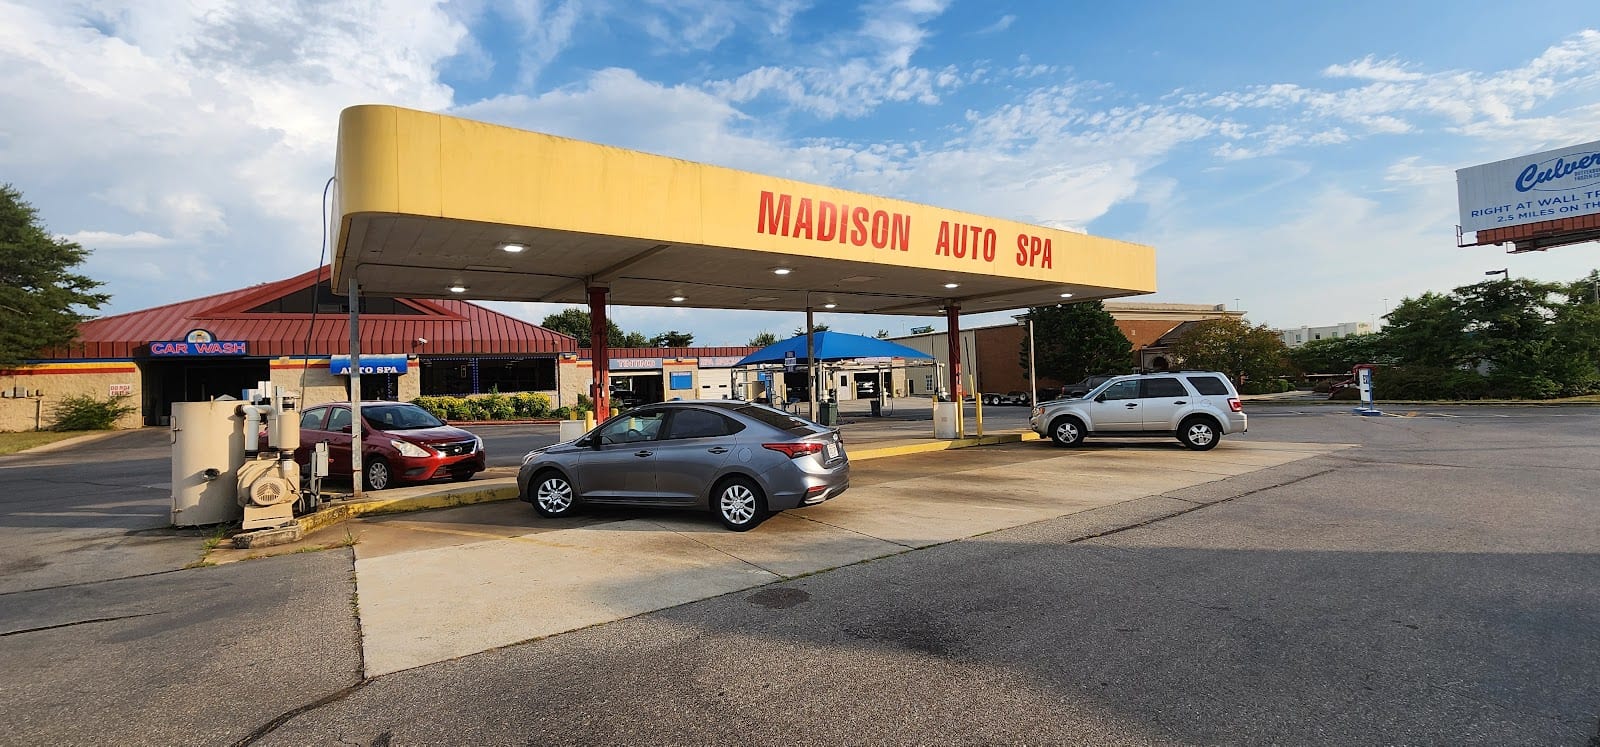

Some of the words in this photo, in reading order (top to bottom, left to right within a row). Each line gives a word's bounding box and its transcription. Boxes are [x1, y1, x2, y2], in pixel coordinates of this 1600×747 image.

[1471, 204, 1511, 218] RIGHT
[1516, 201, 1532, 210] AT
[1538, 193, 1579, 206] WALL
[1497, 215, 1514, 223] 2.5
[1518, 208, 1555, 220] MILES
[1559, 204, 1579, 213] ON
[757, 190, 911, 251] MADISON
[935, 221, 996, 262] AUTO
[1016, 234, 1052, 269] SPA
[151, 343, 188, 354] CAR
[194, 342, 246, 354] WASH
[340, 366, 373, 374] ATO
[376, 366, 398, 374] SPA
